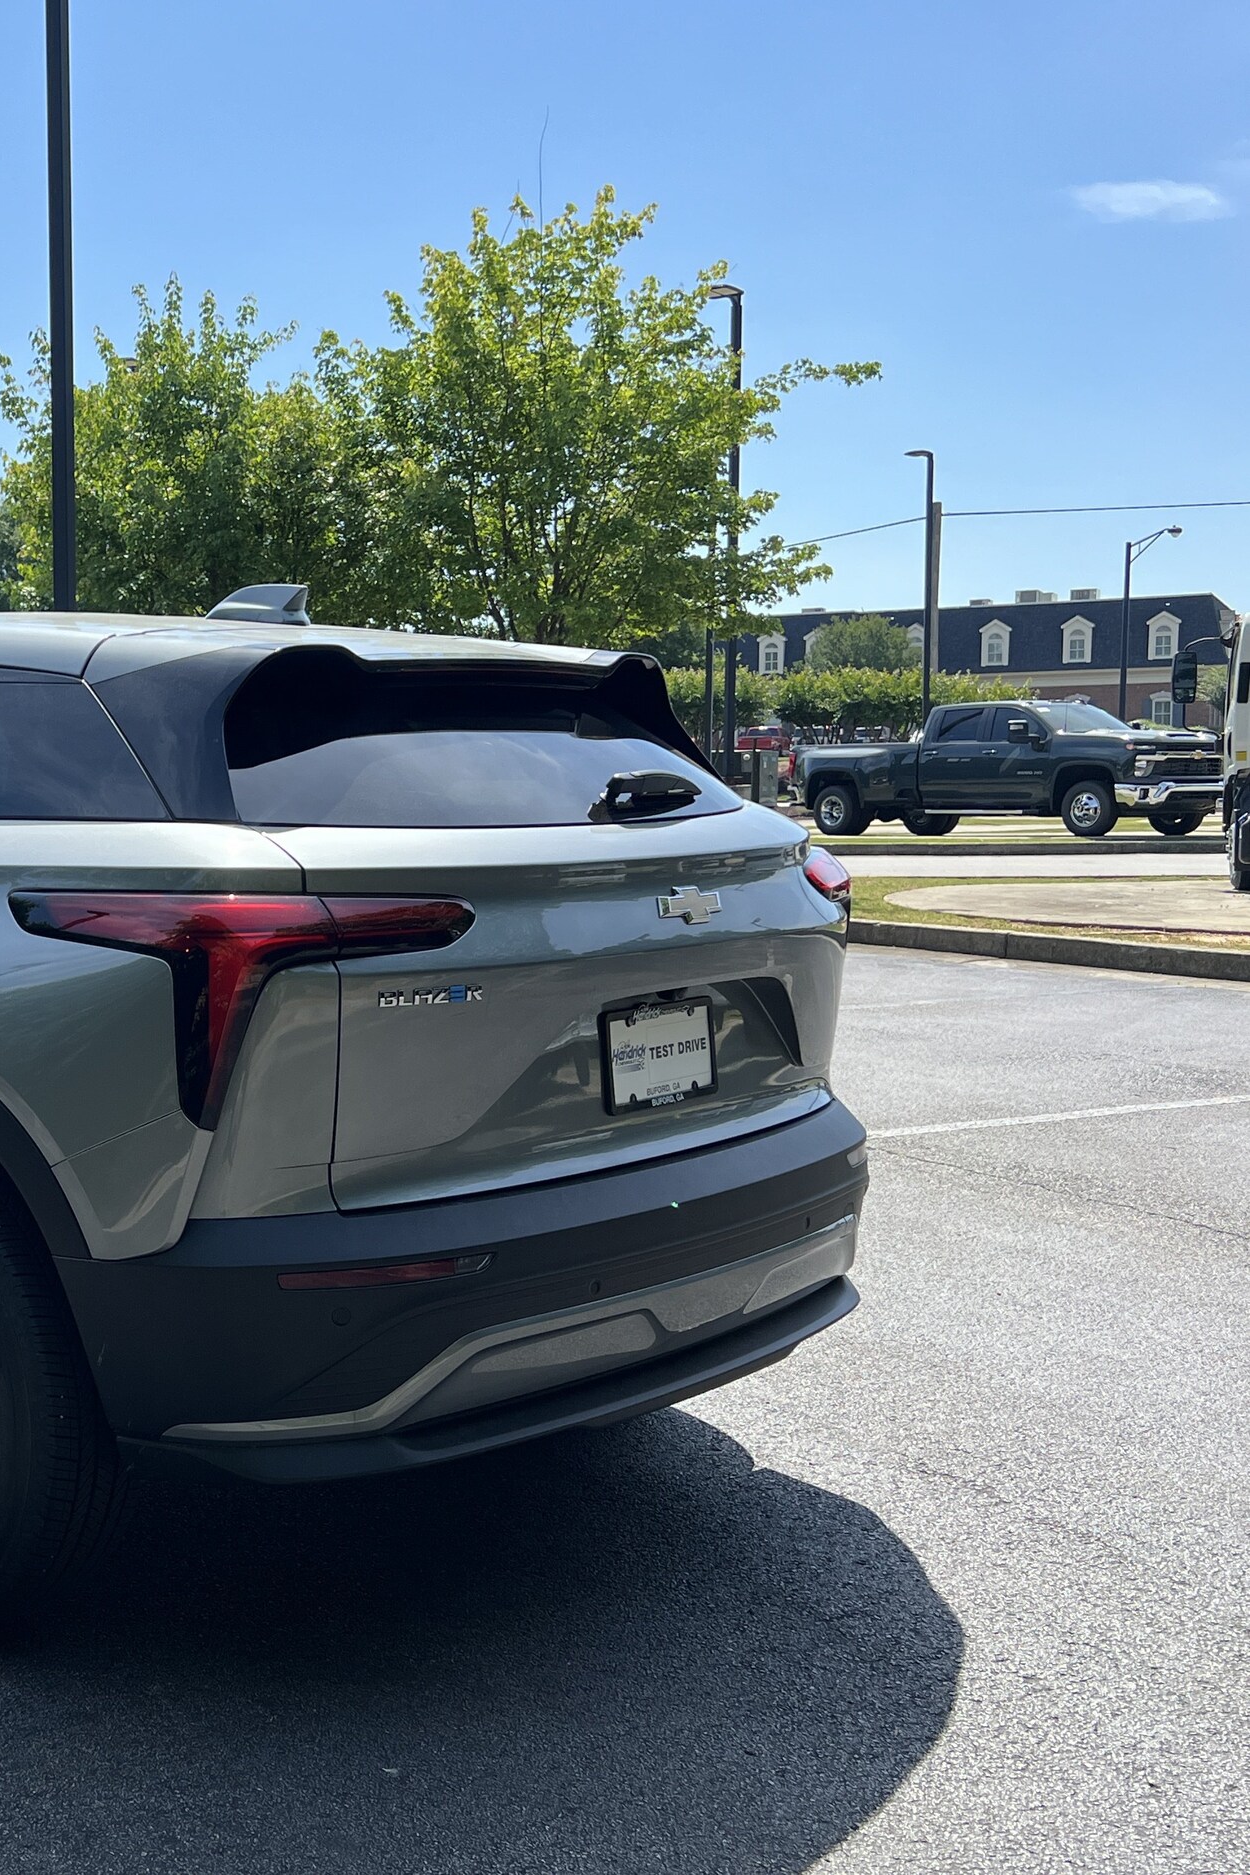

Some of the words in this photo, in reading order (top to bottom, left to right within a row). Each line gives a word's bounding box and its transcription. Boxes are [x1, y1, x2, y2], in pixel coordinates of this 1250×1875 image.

[378, 984, 483, 1008] BLAZER
[649, 1043, 674, 1059] TEST
[678, 1038, 706, 1054] DRIVE
[672, 1081, 681, 1091] GA
[676, 1092, 685, 1102] GA
